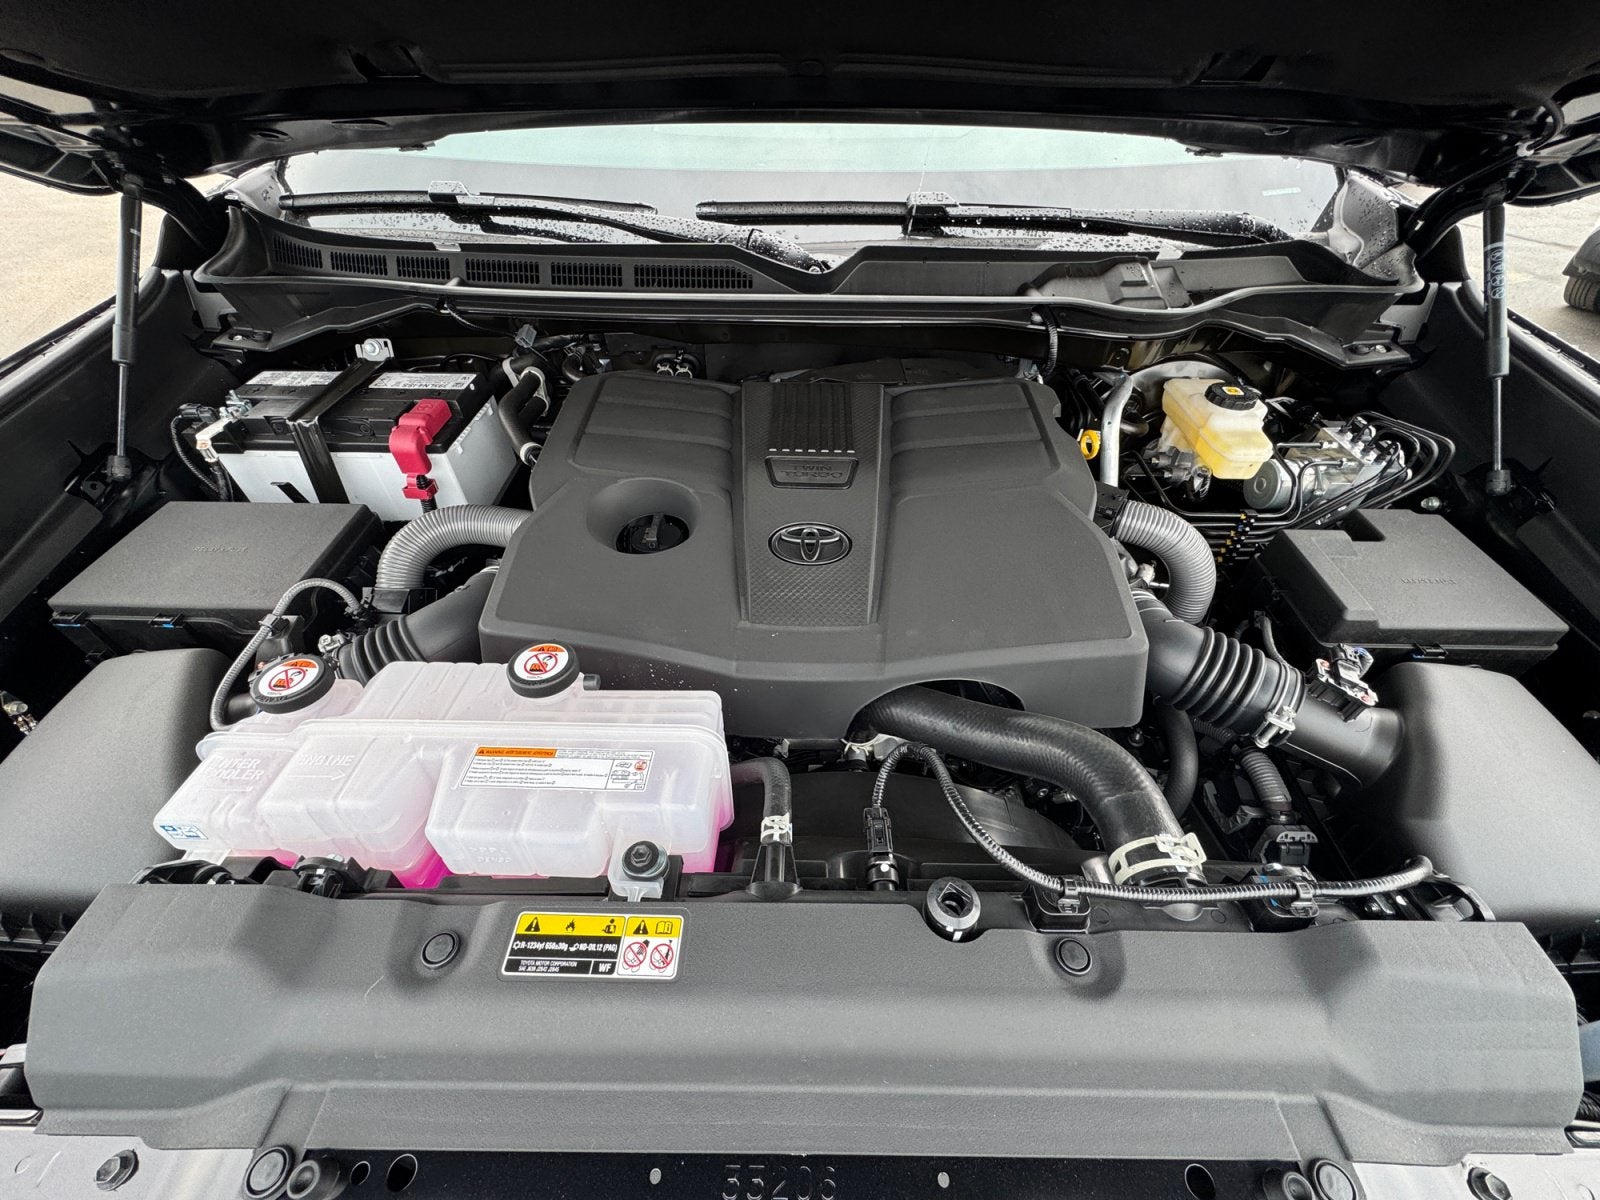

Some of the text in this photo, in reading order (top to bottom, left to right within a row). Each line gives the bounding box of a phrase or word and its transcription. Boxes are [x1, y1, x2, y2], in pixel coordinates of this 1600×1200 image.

[780, 470, 843, 478] TURBO
[299, 754, 355, 766] ENGINE
[598, 963, 612, 973] WF
